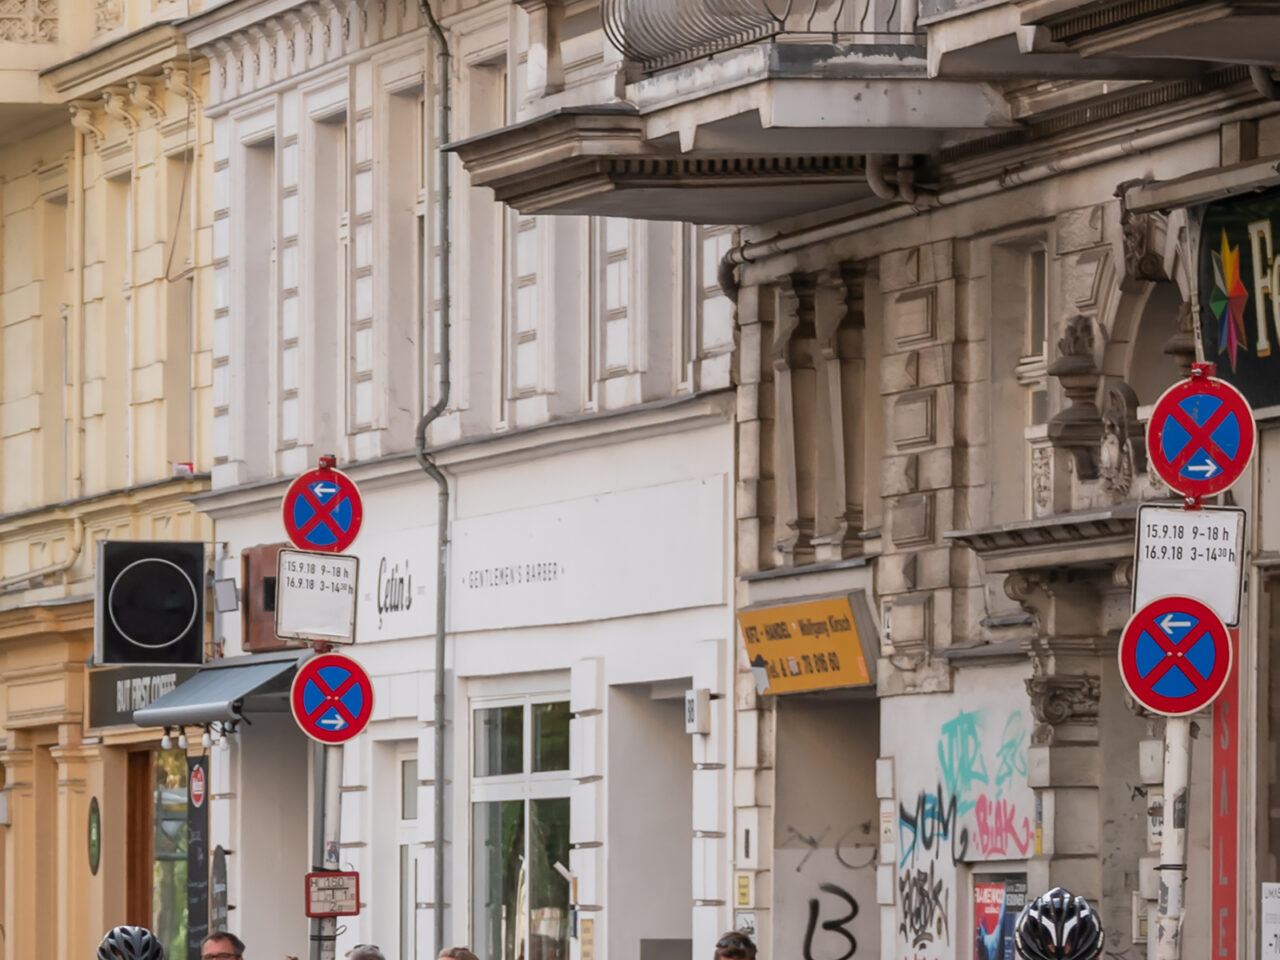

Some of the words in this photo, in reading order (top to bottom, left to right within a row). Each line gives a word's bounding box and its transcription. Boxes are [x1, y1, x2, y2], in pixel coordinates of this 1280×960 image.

[1146, 524, 1185, 540] 15.9.18
[1222, 527, 1229, 541] h
[1145, 545, 1183, 560] 16.9.18
[287, 561, 316, 575] 15.9.18
[526, 561, 558, 583] BARBER
[286, 576, 315, 590] 16.9.18
